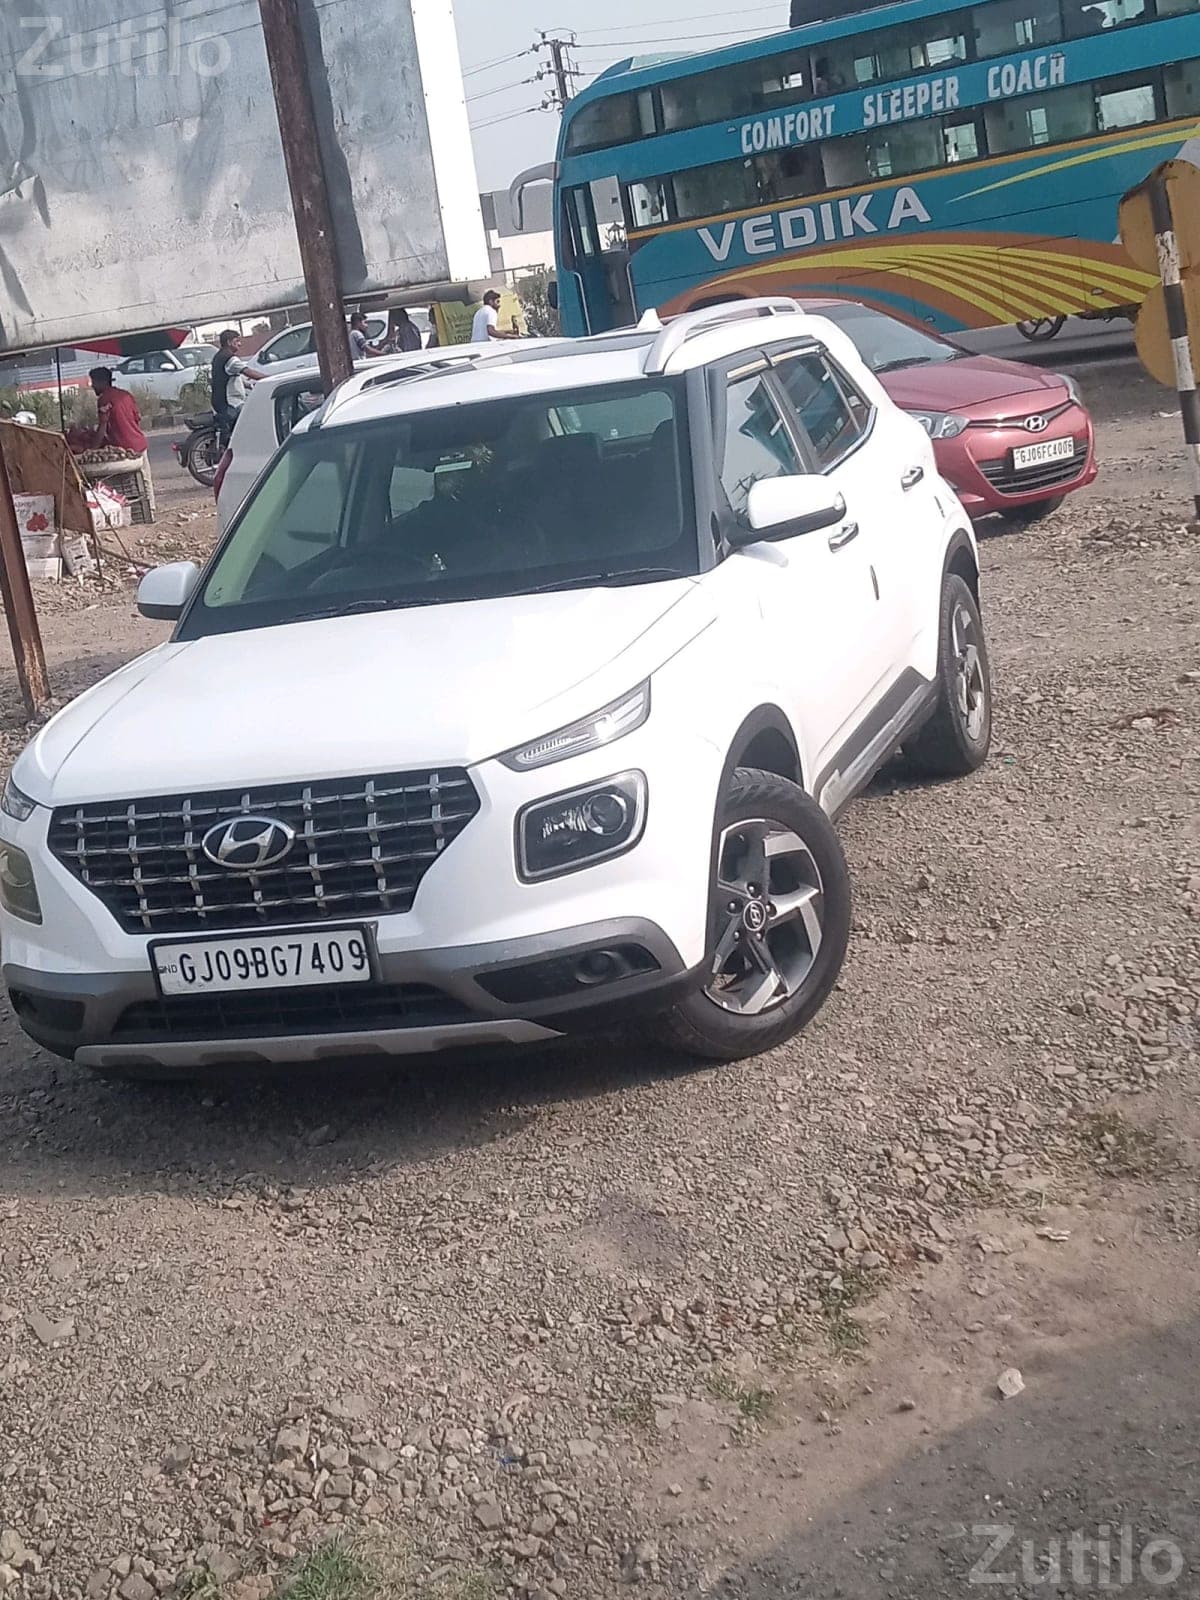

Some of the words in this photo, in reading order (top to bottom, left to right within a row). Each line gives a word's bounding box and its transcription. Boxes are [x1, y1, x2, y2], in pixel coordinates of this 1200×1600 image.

[741, 104, 836, 154] COMFORT
[863, 75, 960, 126] SLEEPER
[987, 55, 1065, 98] COACH
[697, 186, 932, 263] VEDIKA
[1020, 440, 1073, 463] GJ06FC4006
[179, 938, 367, 984] GJ09BG7409
